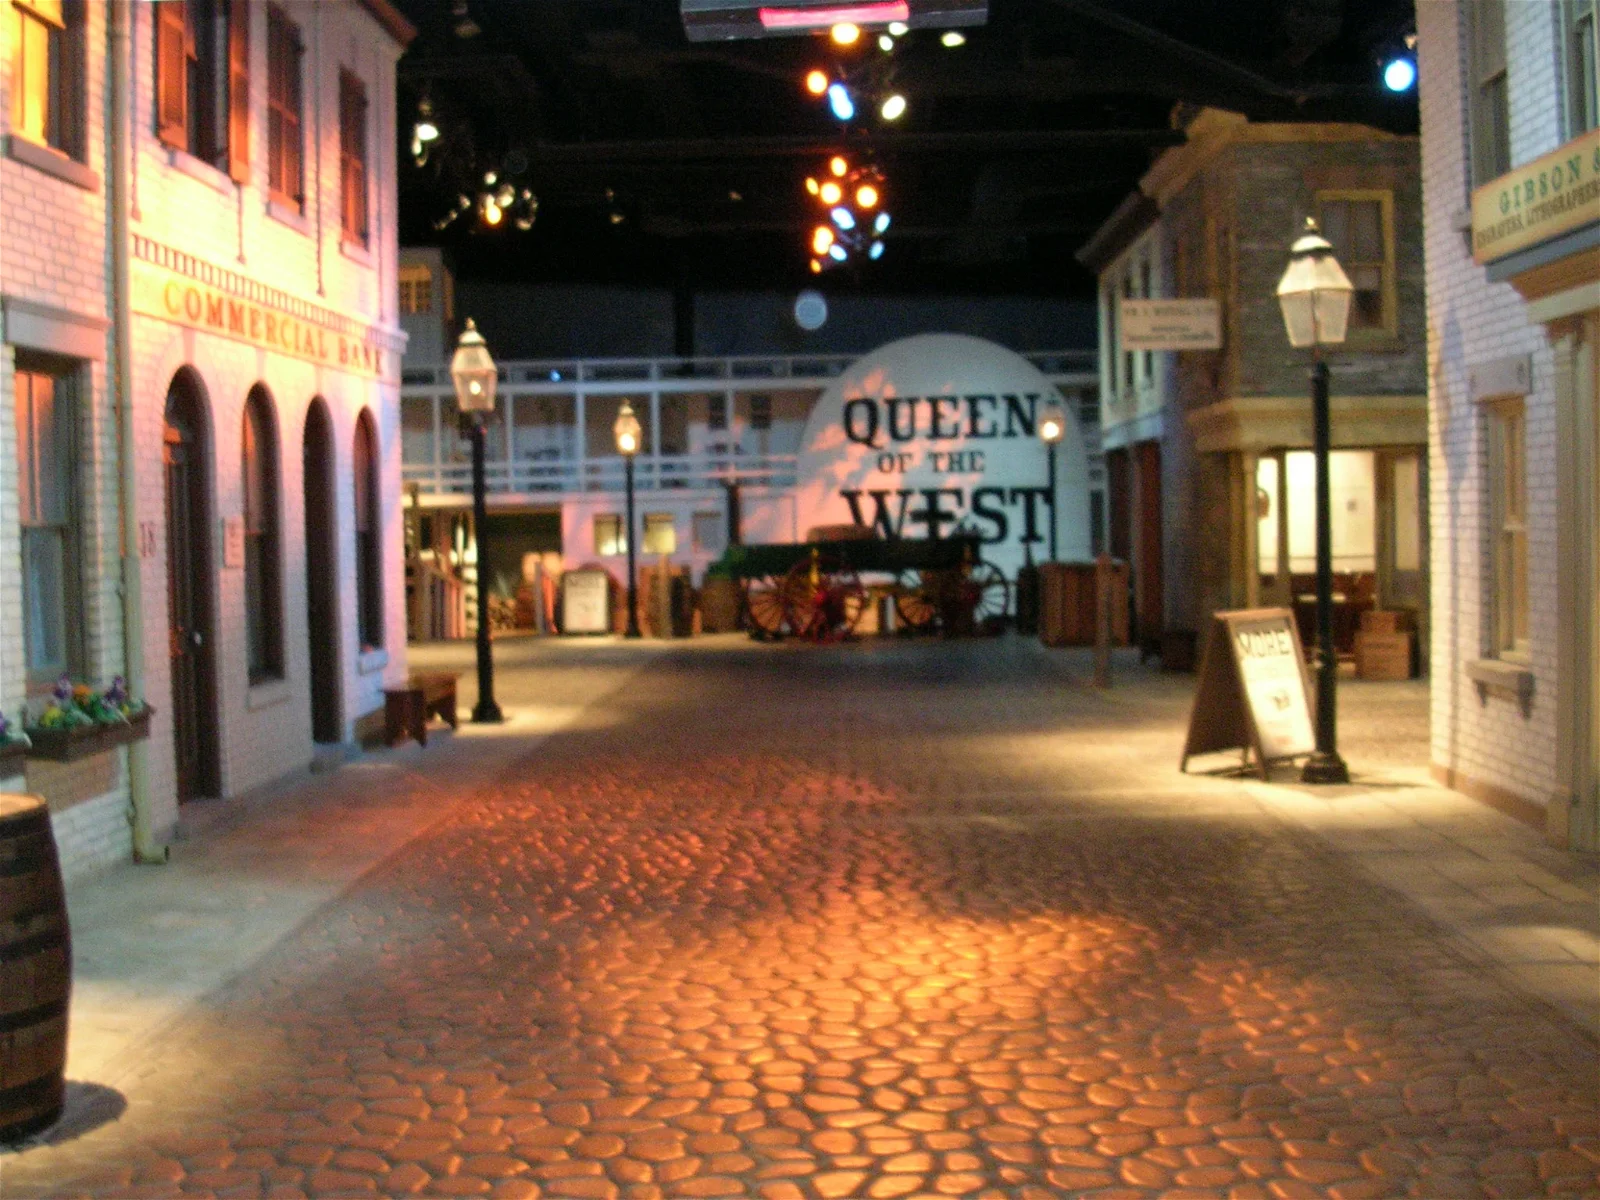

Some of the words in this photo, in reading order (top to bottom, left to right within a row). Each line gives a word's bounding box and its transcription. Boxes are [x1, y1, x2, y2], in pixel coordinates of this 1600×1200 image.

[1499, 154, 1582, 215] GIBSON
[164, 279, 329, 360] COMMERCIAL
[338, 335, 383, 376] BANK
[843, 393, 1041, 450] QUEEN
[877, 452, 912, 474] OF
[929, 451, 986, 474] THE
[840, 486, 1051, 545] WEST
